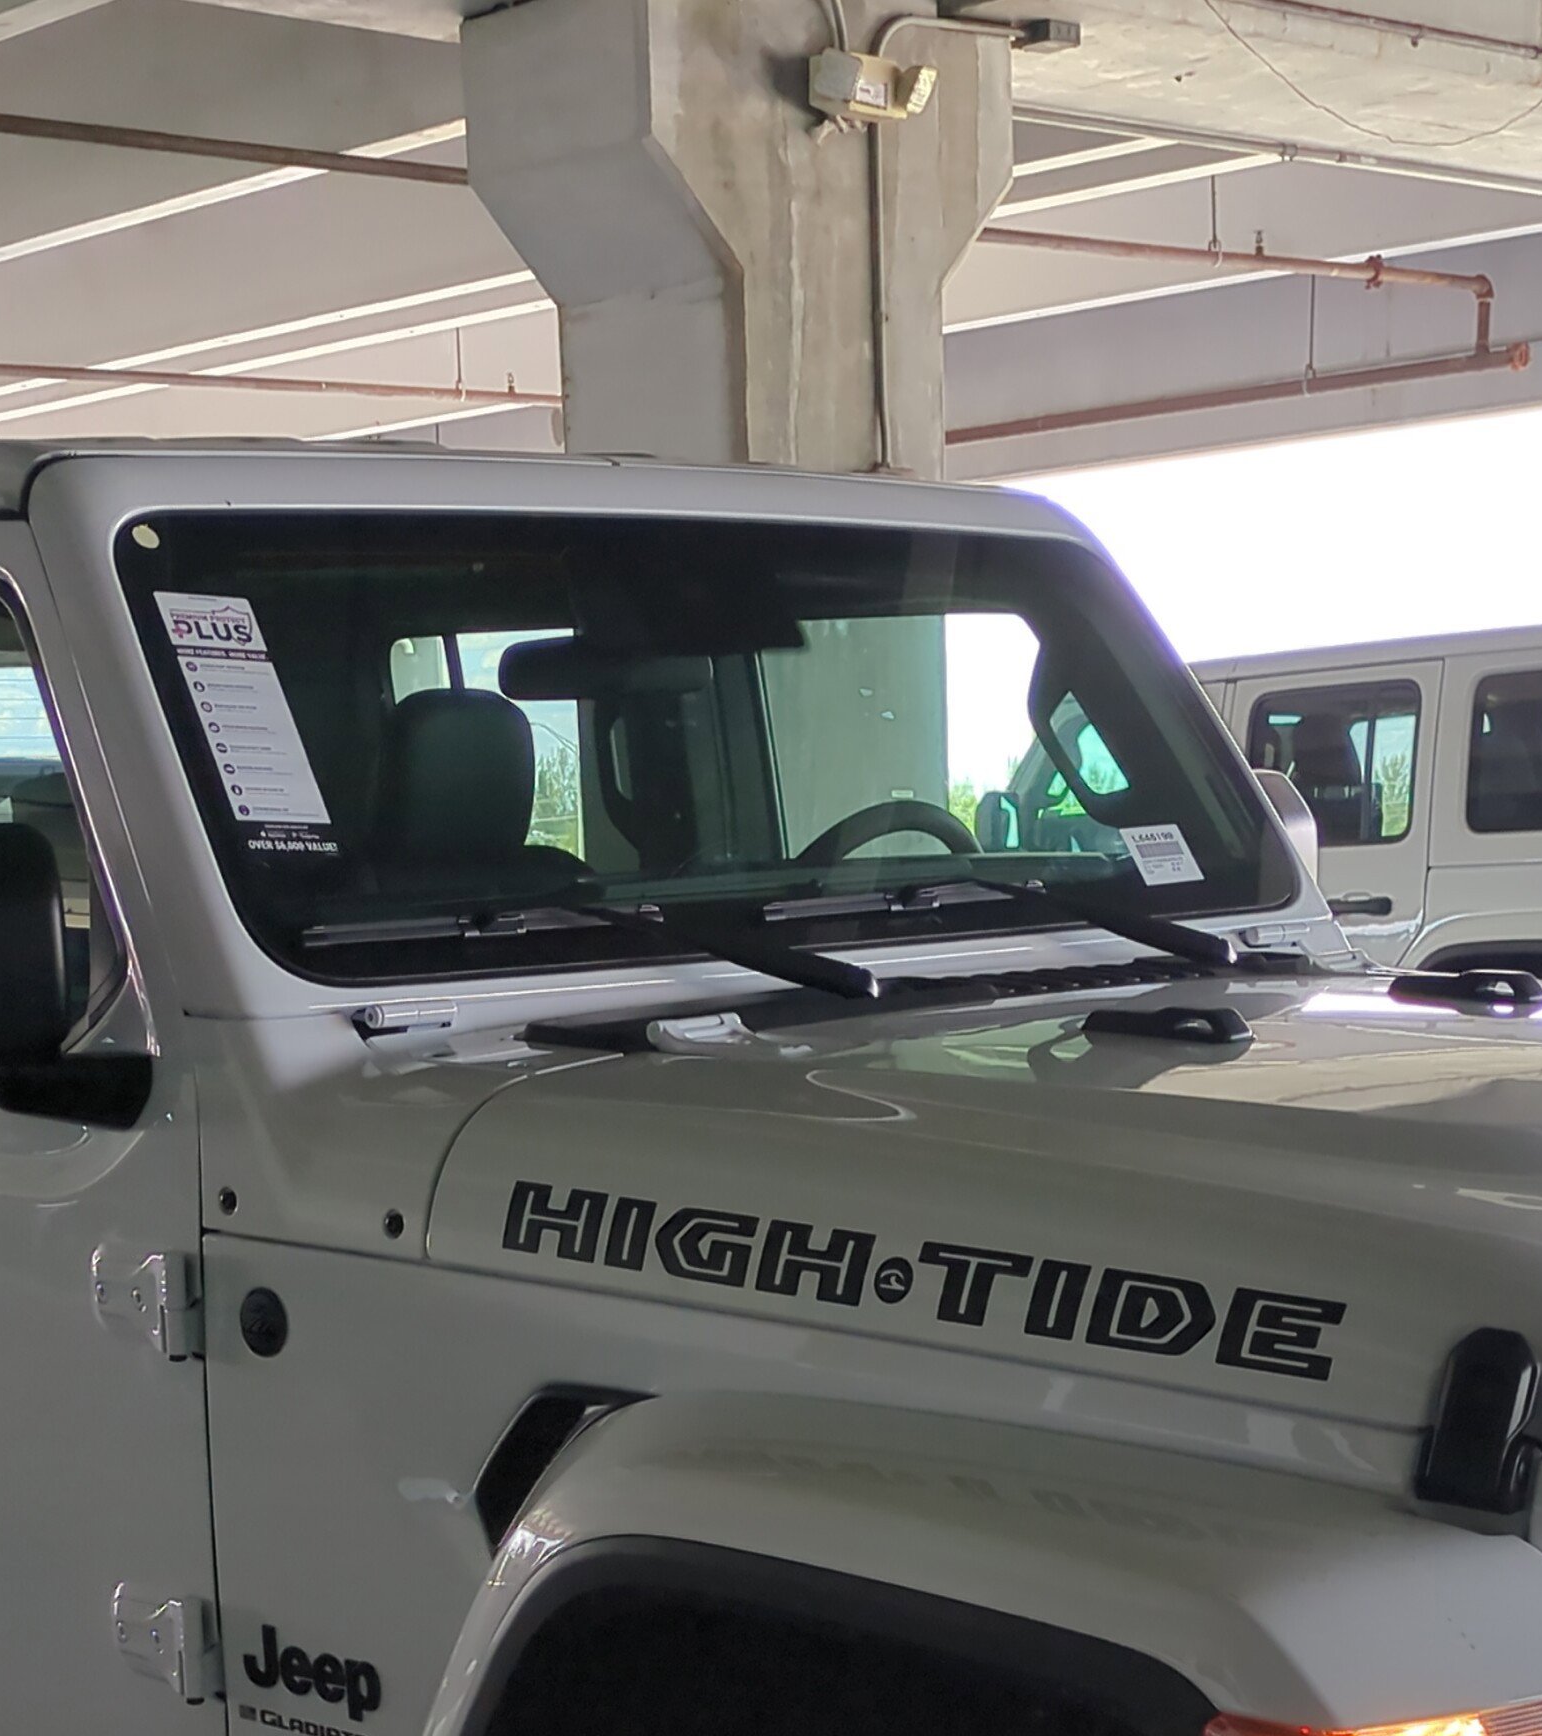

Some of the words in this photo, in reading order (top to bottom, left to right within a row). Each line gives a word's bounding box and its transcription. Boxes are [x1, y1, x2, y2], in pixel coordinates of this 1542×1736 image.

[172, 620, 252, 643] PLUS
[247, 840, 274, 850] OVER
[502, 1180, 876, 1307] HIGH
[918, 1241, 1348, 1382] TIDE
[242, 1623, 382, 1723] Jeep
